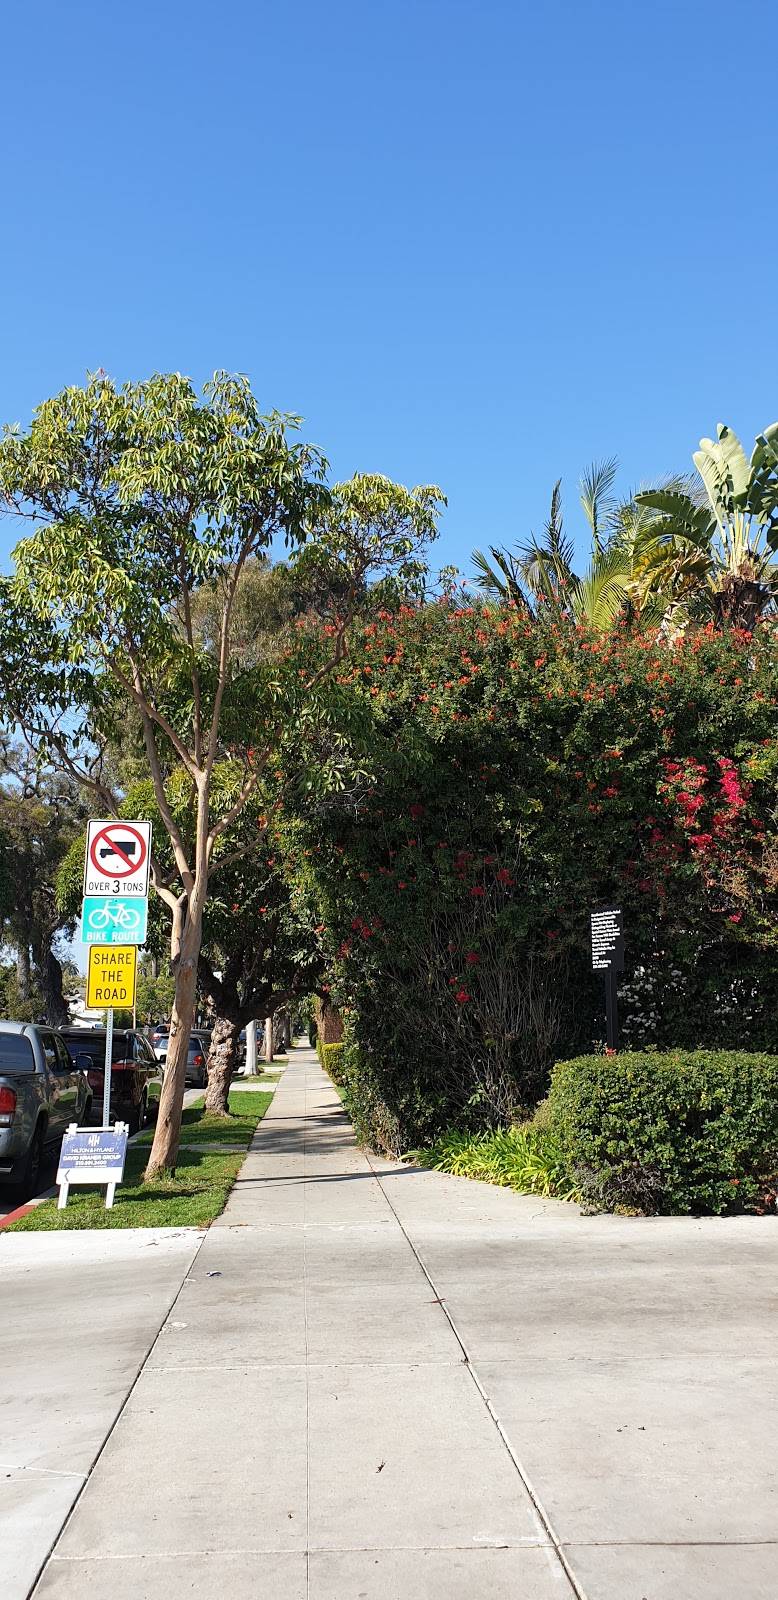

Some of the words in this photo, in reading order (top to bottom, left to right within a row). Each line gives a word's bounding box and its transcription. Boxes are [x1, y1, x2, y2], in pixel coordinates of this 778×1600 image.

[88, 880, 110, 891] OVER
[112, 879, 120, 894] 3
[122, 880, 144, 892] TONS
[86, 931, 107, 942] BIKE
[112, 931, 140, 942] ROUTE
[93, 952, 132, 965] SHARE
[101, 970, 123, 982] THE
[95, 987, 127, 1000] ROAD
